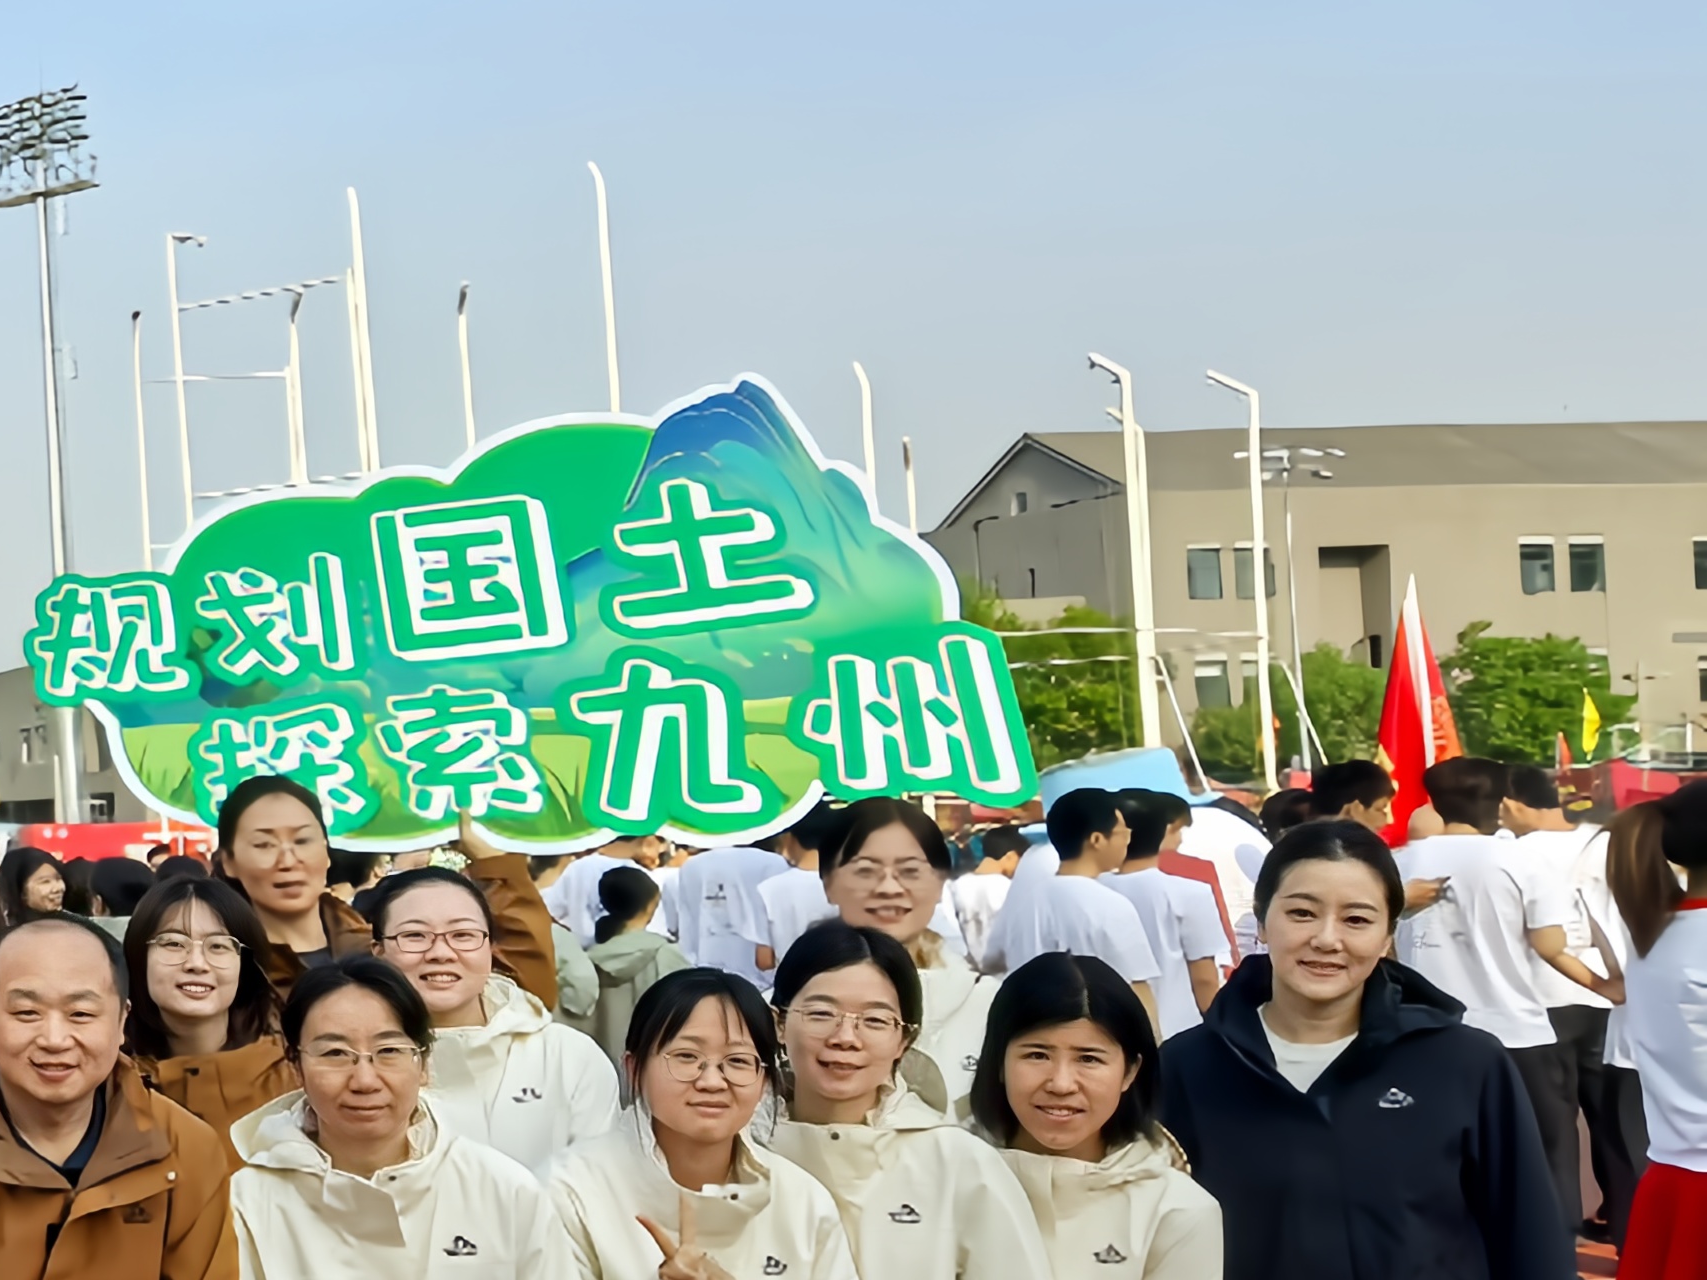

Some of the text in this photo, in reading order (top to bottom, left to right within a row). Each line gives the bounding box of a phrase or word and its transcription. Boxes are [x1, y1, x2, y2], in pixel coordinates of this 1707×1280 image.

[43, 477, 815, 696] 规划国土
[196, 632, 1018, 824] 探索九州
